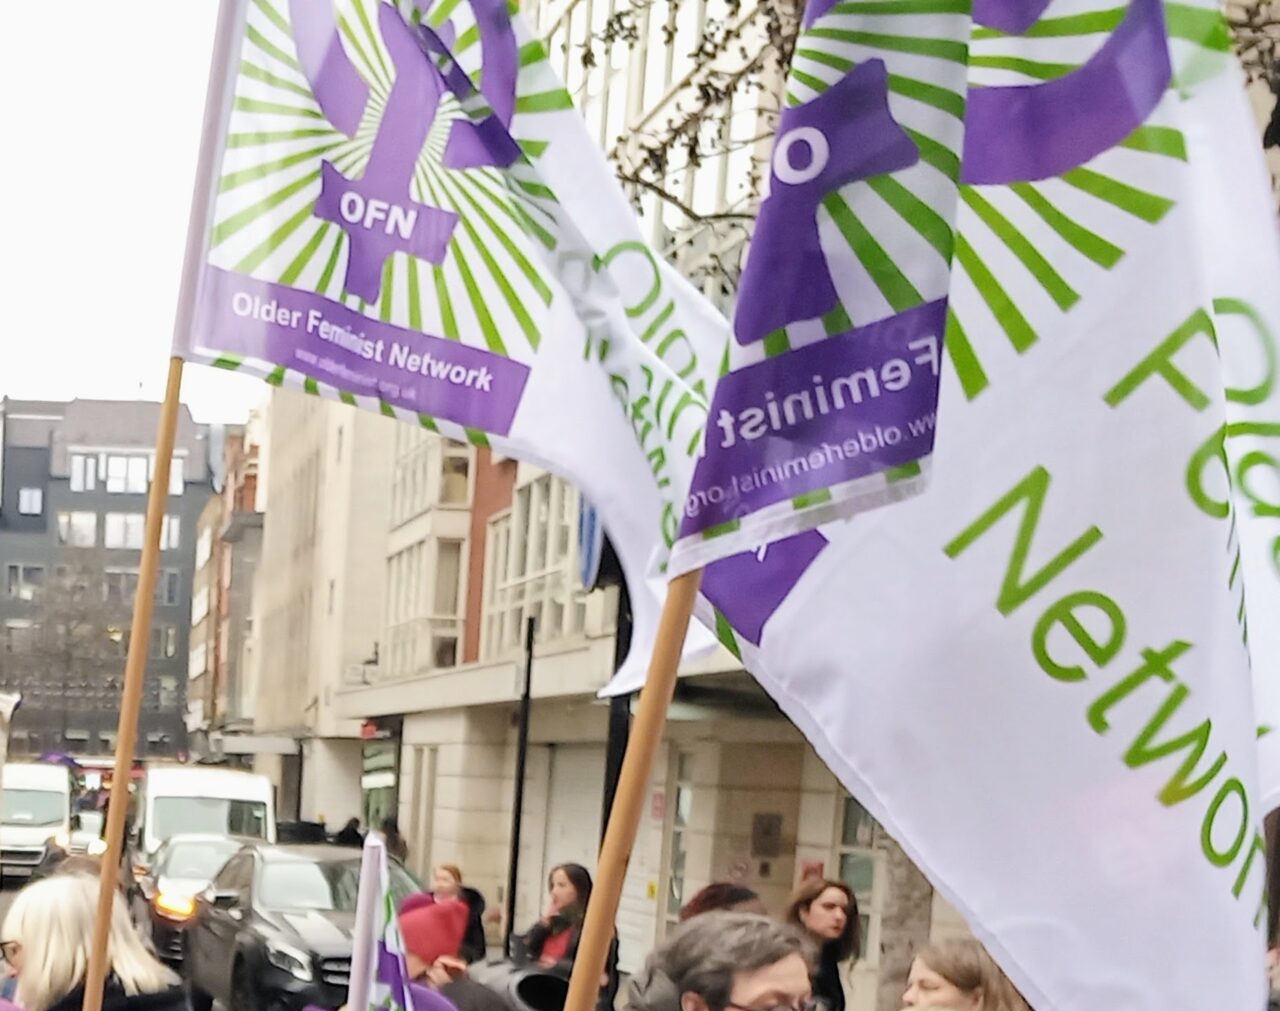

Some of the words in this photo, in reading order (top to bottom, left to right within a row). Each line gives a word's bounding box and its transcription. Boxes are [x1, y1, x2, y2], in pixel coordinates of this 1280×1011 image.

[340, 190, 418, 240] OFN
[231, 292, 302, 330] Older
[388, 342, 494, 393] Network
[942, 463, 1269, 928] Networ
